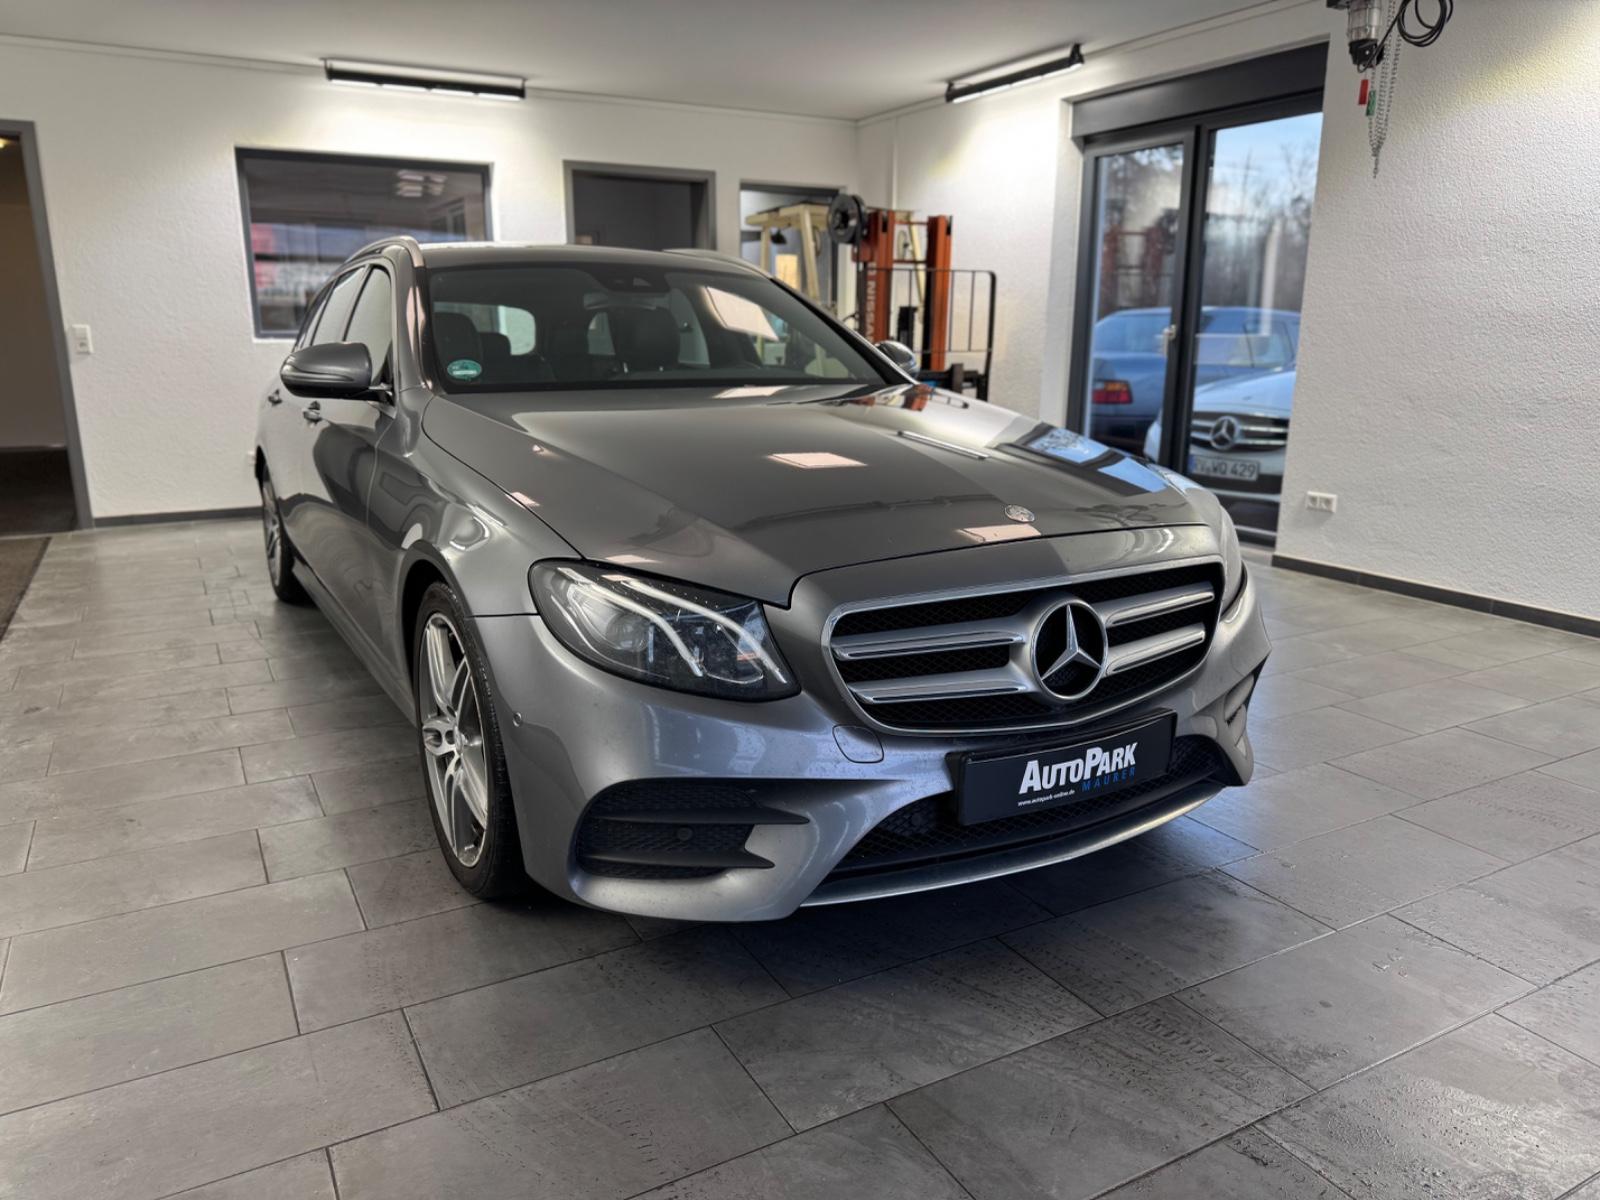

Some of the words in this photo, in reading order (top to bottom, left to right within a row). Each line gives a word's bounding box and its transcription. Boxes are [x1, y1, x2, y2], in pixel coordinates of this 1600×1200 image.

[1230, 462, 1256, 478] 429
[1081, 766, 1136, 792] MAURER
[1017, 788, 1076, 807] www.autopark-online.de
